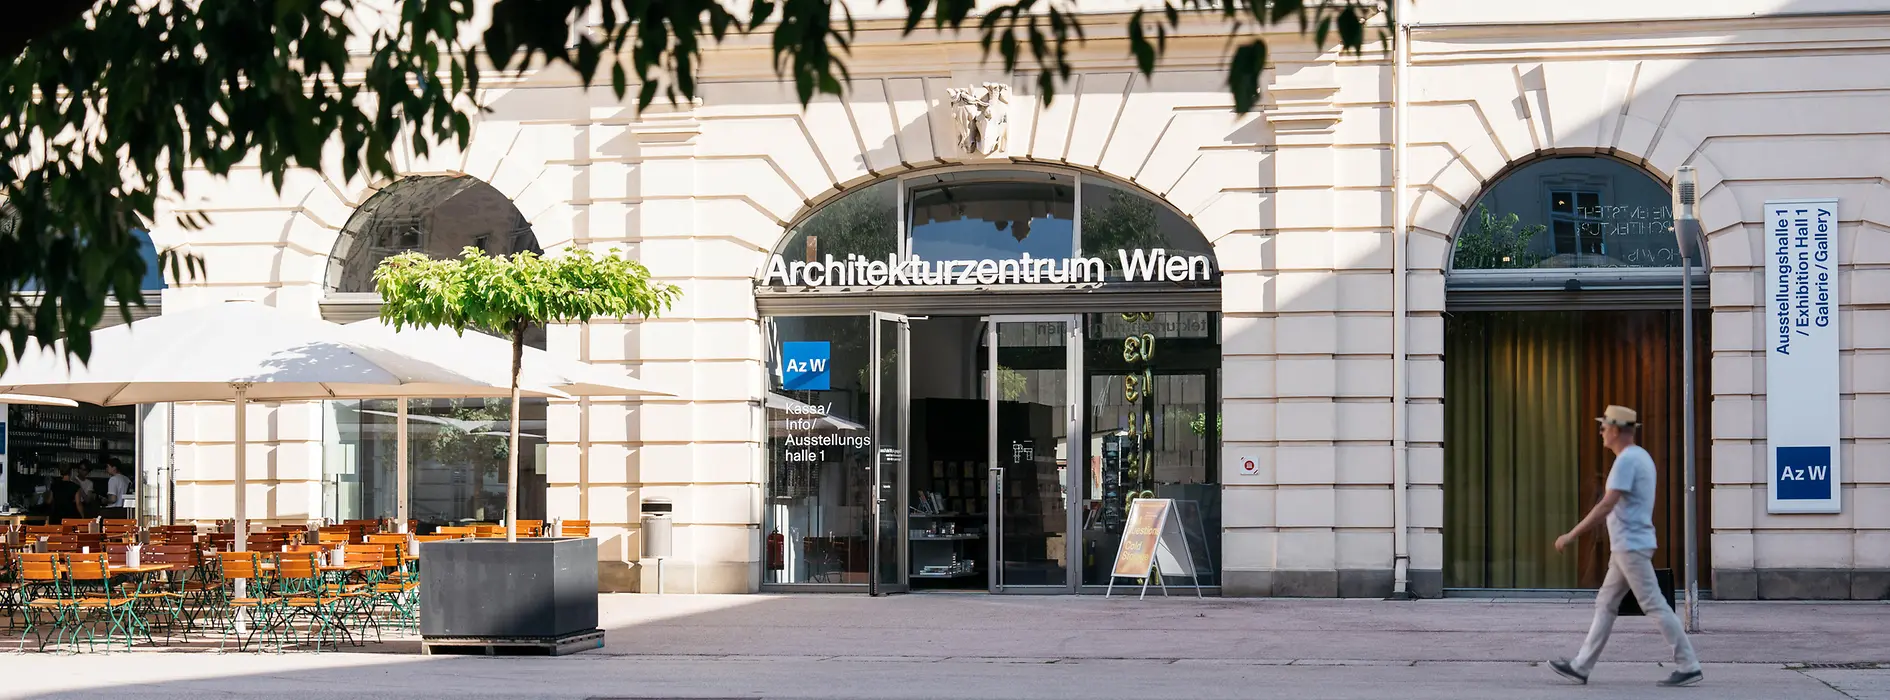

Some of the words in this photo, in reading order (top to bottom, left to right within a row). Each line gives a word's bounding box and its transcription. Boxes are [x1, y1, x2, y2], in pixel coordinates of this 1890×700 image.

[1794, 219, 1808, 247] Hall
[1814, 208, 1831, 262] Gallery
[762, 252, 1105, 286] Architekturzentrum
[1118, 248, 1211, 282] Wien
[1775, 218, 1792, 355] Ausstellungshalle
[1795, 252, 1809, 327] Exhibition
[1815, 272, 1829, 327] Galerie
[785, 402, 832, 415] Kassa/
[786, 418, 817, 430] Info/
[785, 434, 871, 448] Ausstellungs
[785, 449, 816, 462] halle
[819, 450, 825, 462] 1
